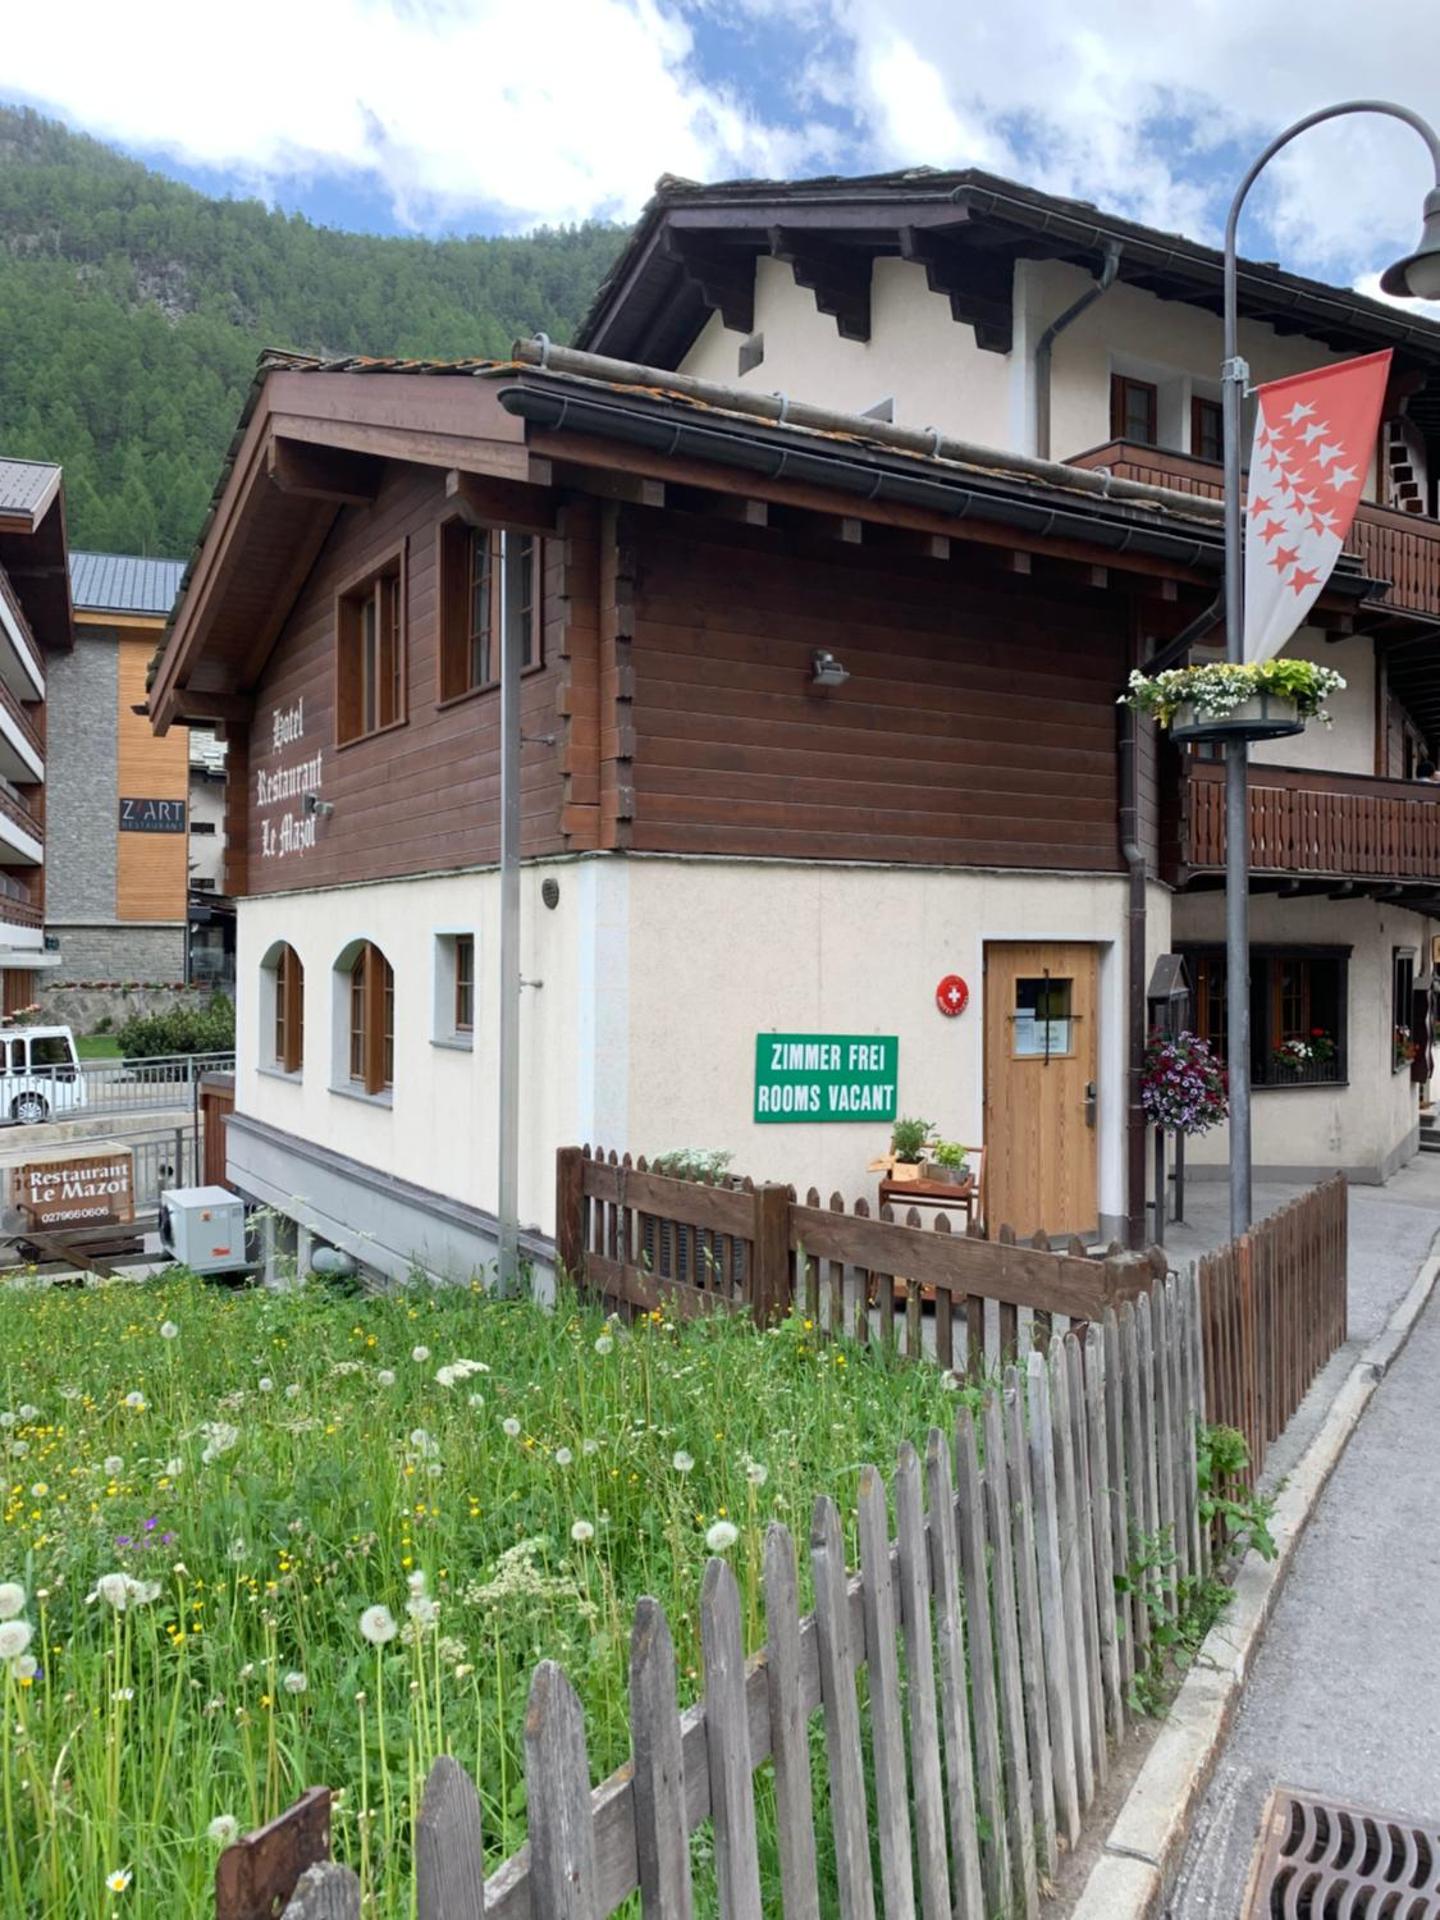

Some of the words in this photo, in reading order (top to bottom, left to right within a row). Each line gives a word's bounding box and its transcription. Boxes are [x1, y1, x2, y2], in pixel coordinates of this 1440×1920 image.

[272, 696, 304, 755] Hotel
[256, 749, 323, 807] Restaurant
[261, 818, 276, 858] Le
[278, 812, 317, 858] Mazot
[770, 1043, 841, 1071] ZIMMER
[848, 1044, 885, 1071] FREI
[757, 1084, 821, 1112] ROOMS
[828, 1084, 895, 1112] VACANT
[30, 1163, 129, 1187] Restaurant
[31, 1186, 56, 1204] Le
[61, 1178, 129, 1201] Mazot
